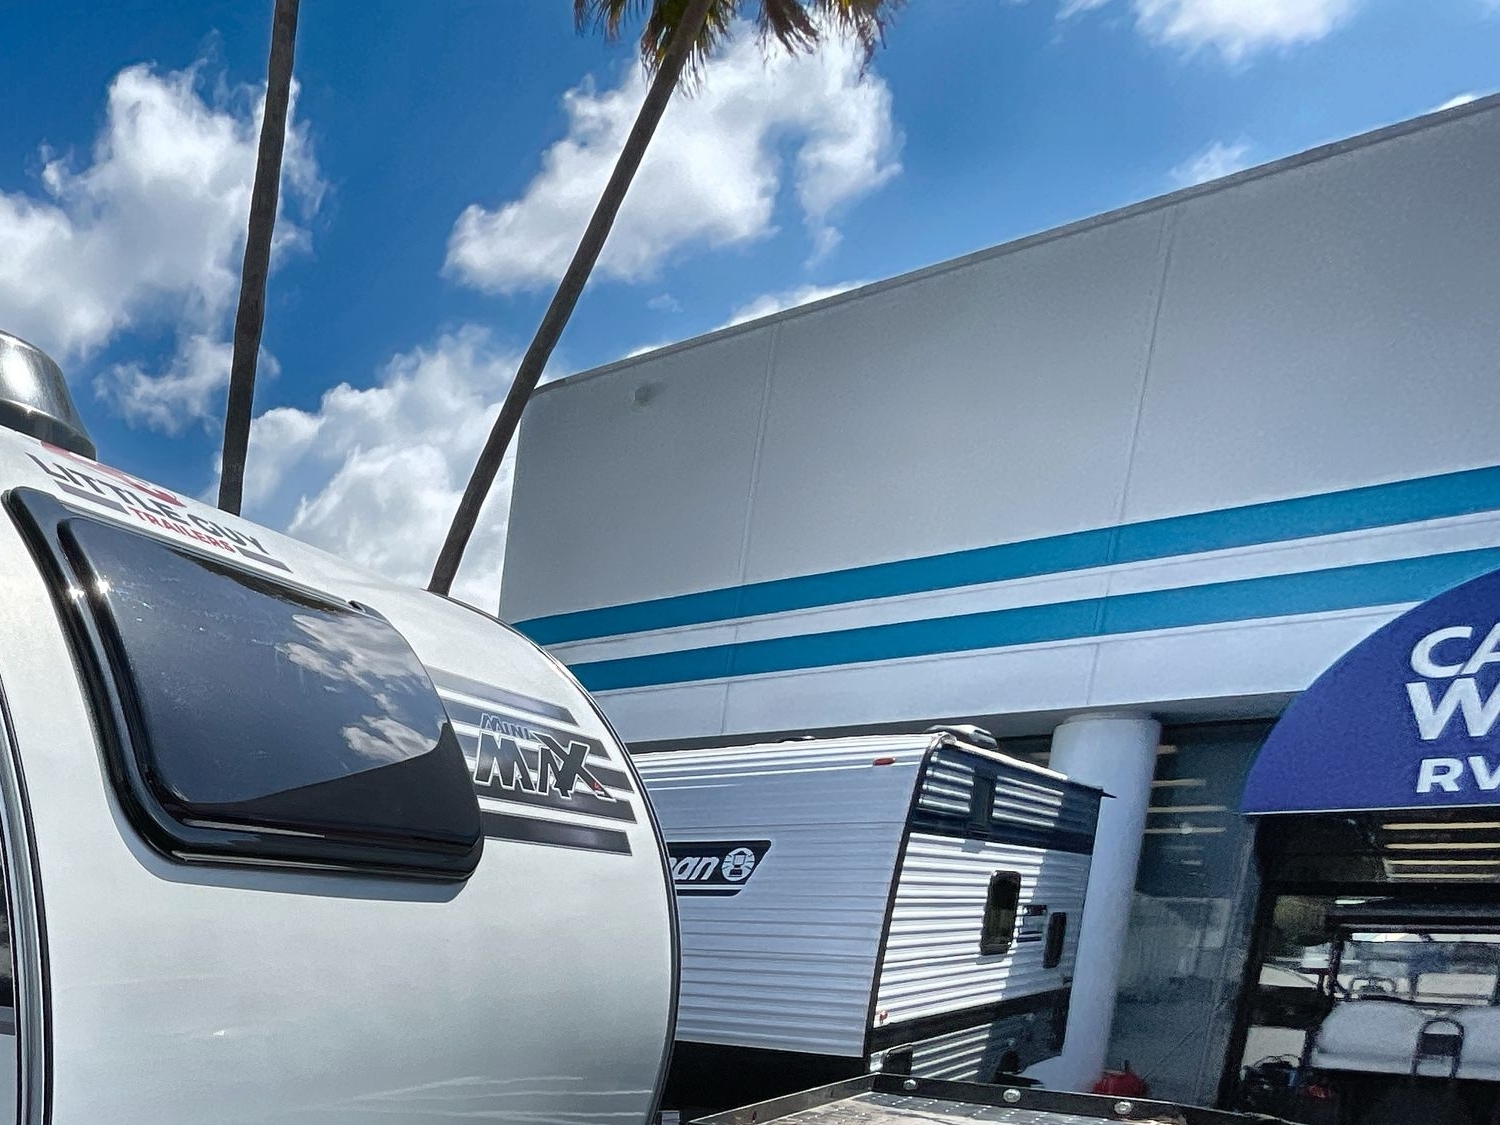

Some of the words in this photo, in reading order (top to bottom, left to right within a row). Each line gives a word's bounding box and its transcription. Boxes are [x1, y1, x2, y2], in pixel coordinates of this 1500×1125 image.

[25, 452, 189, 525] LITTLE
[186, 513, 269, 554] GUY
[129, 506, 236, 553] TRAILERS
[480, 713, 530, 739] MINI
